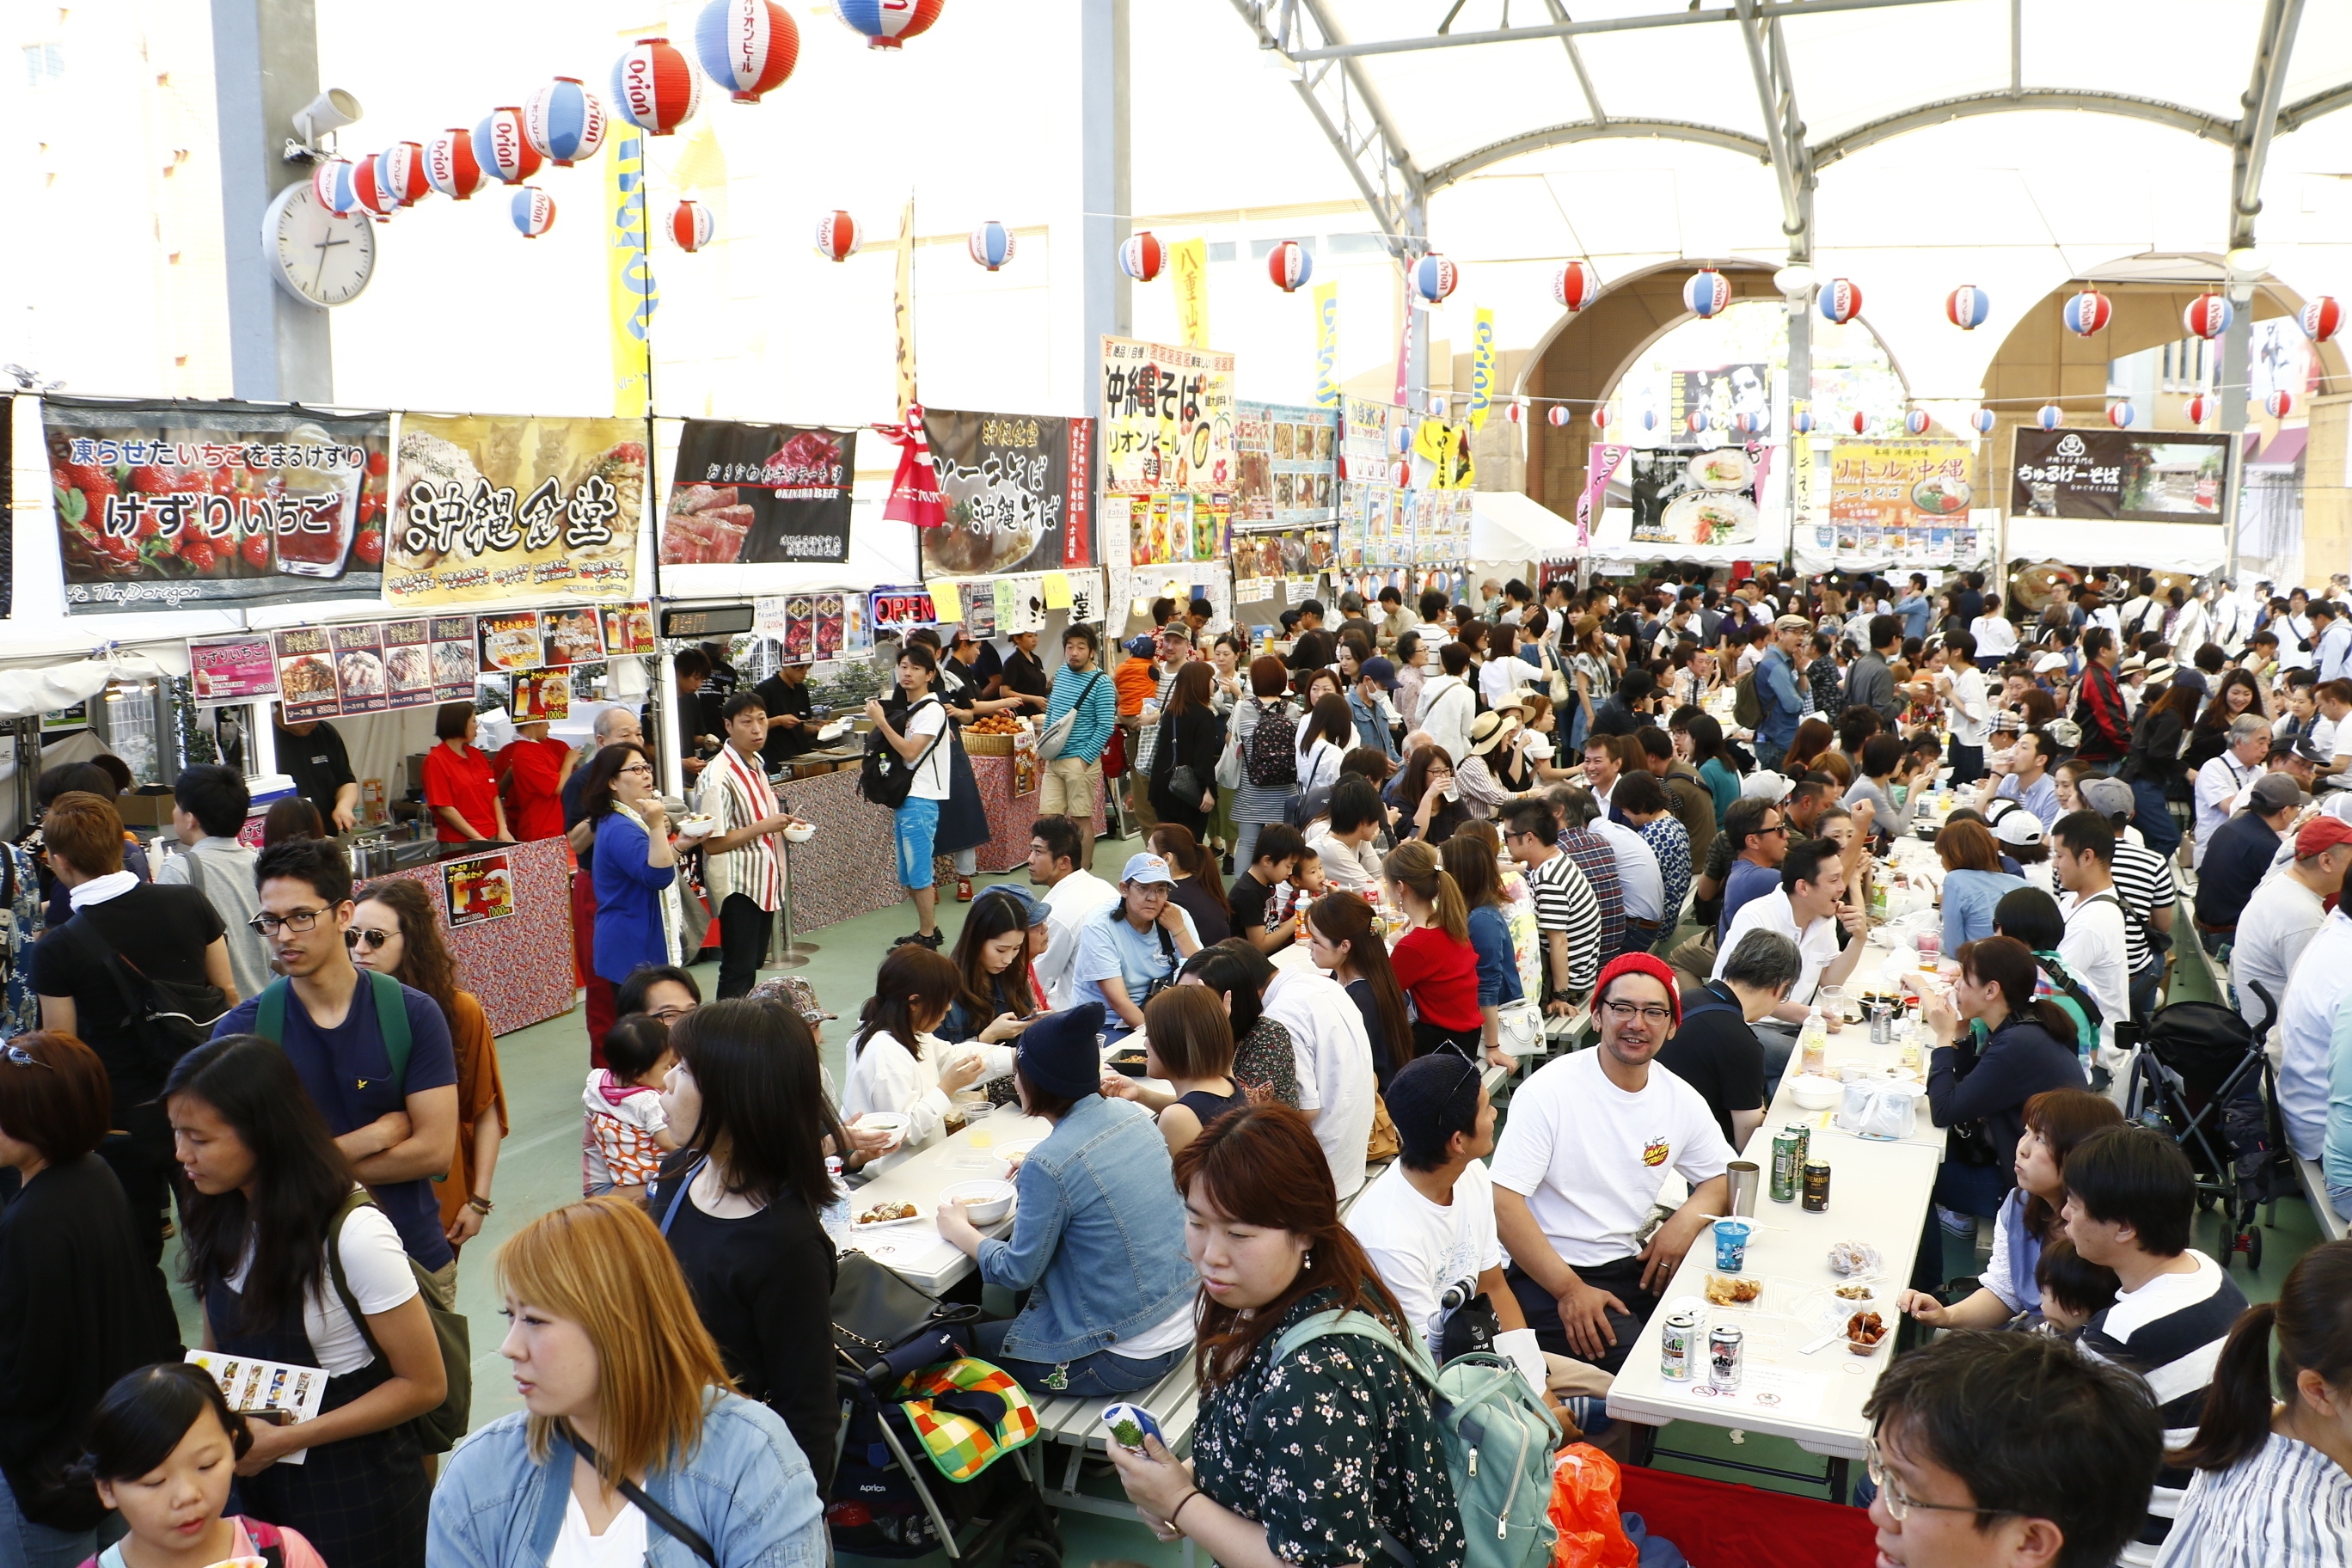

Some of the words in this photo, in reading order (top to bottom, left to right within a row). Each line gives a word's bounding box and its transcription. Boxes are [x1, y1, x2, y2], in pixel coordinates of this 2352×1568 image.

[628, 59, 651, 116] Orion
[585, 94, 600, 143] Orion
[495, 122, 515, 168] Orion
[434, 139, 449, 181] Orion
[532, 194, 546, 224] Orion
[821, 217, 830, 247] Orion
[1439, 261, 1451, 291] Orion
[2082, 299, 2093, 327] Orion
[2210, 303, 2220, 331] Orion
[1106, 363, 1200, 422] 沖縄そば
[983, 420, 1038, 447] 沖縄食堂
[1109, 430, 1180, 456] リオンビール
[70, 438, 365, 469] 凍らせたいちごをまるけずり
[932, 451, 1047, 493] ソーキそば
[1836, 458, 1966, 483] リトル沖縄
[2018, 464, 2121, 484] ちゅるげーそば
[775, 488, 812, 499] OKINAWA
[813, 487, 840, 499] BEEF
[105, 493, 338, 537] けずりいちご
[406, 474, 617, 554] 沖縄食堂
[971, 493, 1060, 534] 沖縄そば
[95, 583, 200, 607] TinyDoragon
[756, 600, 775, 610] 石垣牛
[875, 597, 934, 622] OPEN
[197, 640, 265, 667] けずりいちご
[586, 651, 603, 660] 500円
[316, 704, 337, 714] 500円
[367, 700, 386, 709] 600円
[413, 692, 431, 702] 600円
[488, 906, 510, 917] 1000円
[1804, 1173, 1828, 1184] PREMIUM
[860, 1484, 886, 1493] Aprica
